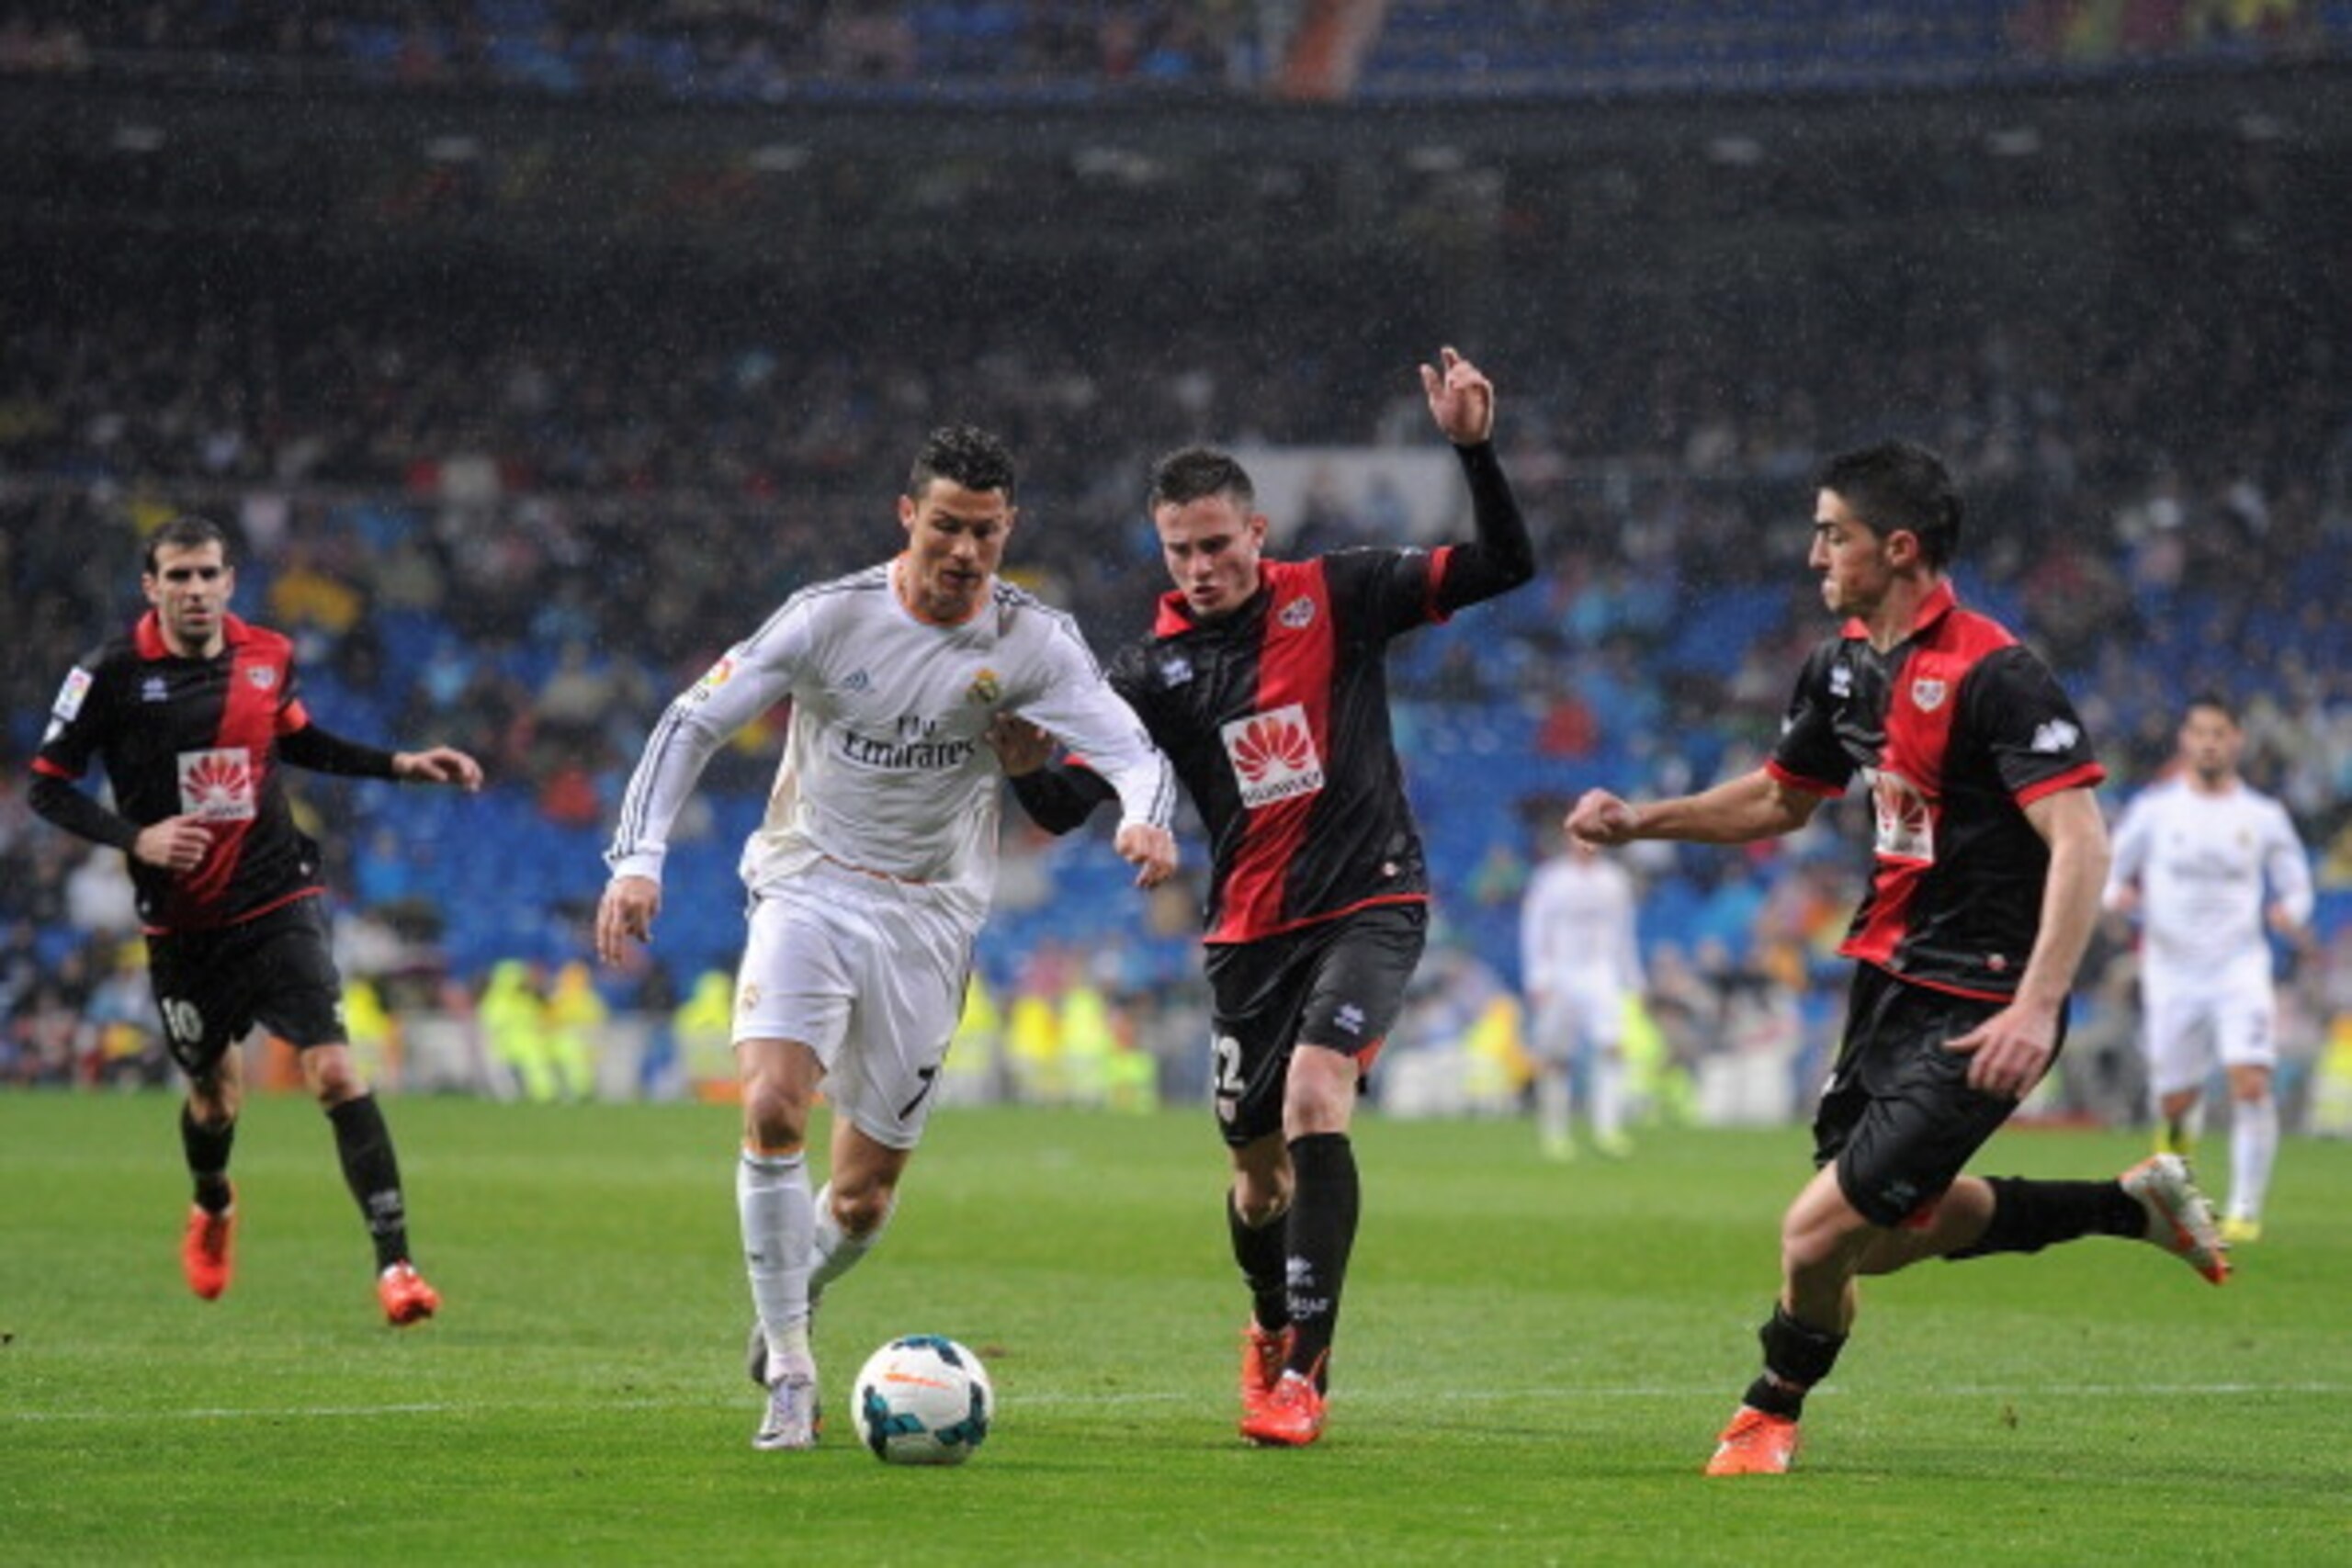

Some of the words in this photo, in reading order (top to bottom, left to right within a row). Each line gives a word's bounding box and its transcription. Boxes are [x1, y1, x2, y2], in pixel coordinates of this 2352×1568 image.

[842, 731, 976, 768] Emirates
[897, 716, 935, 739] Fly
[162, 998, 203, 1042] 10
[1211, 1032, 1245, 1090] 2
[899, 1066, 935, 1121] 7
